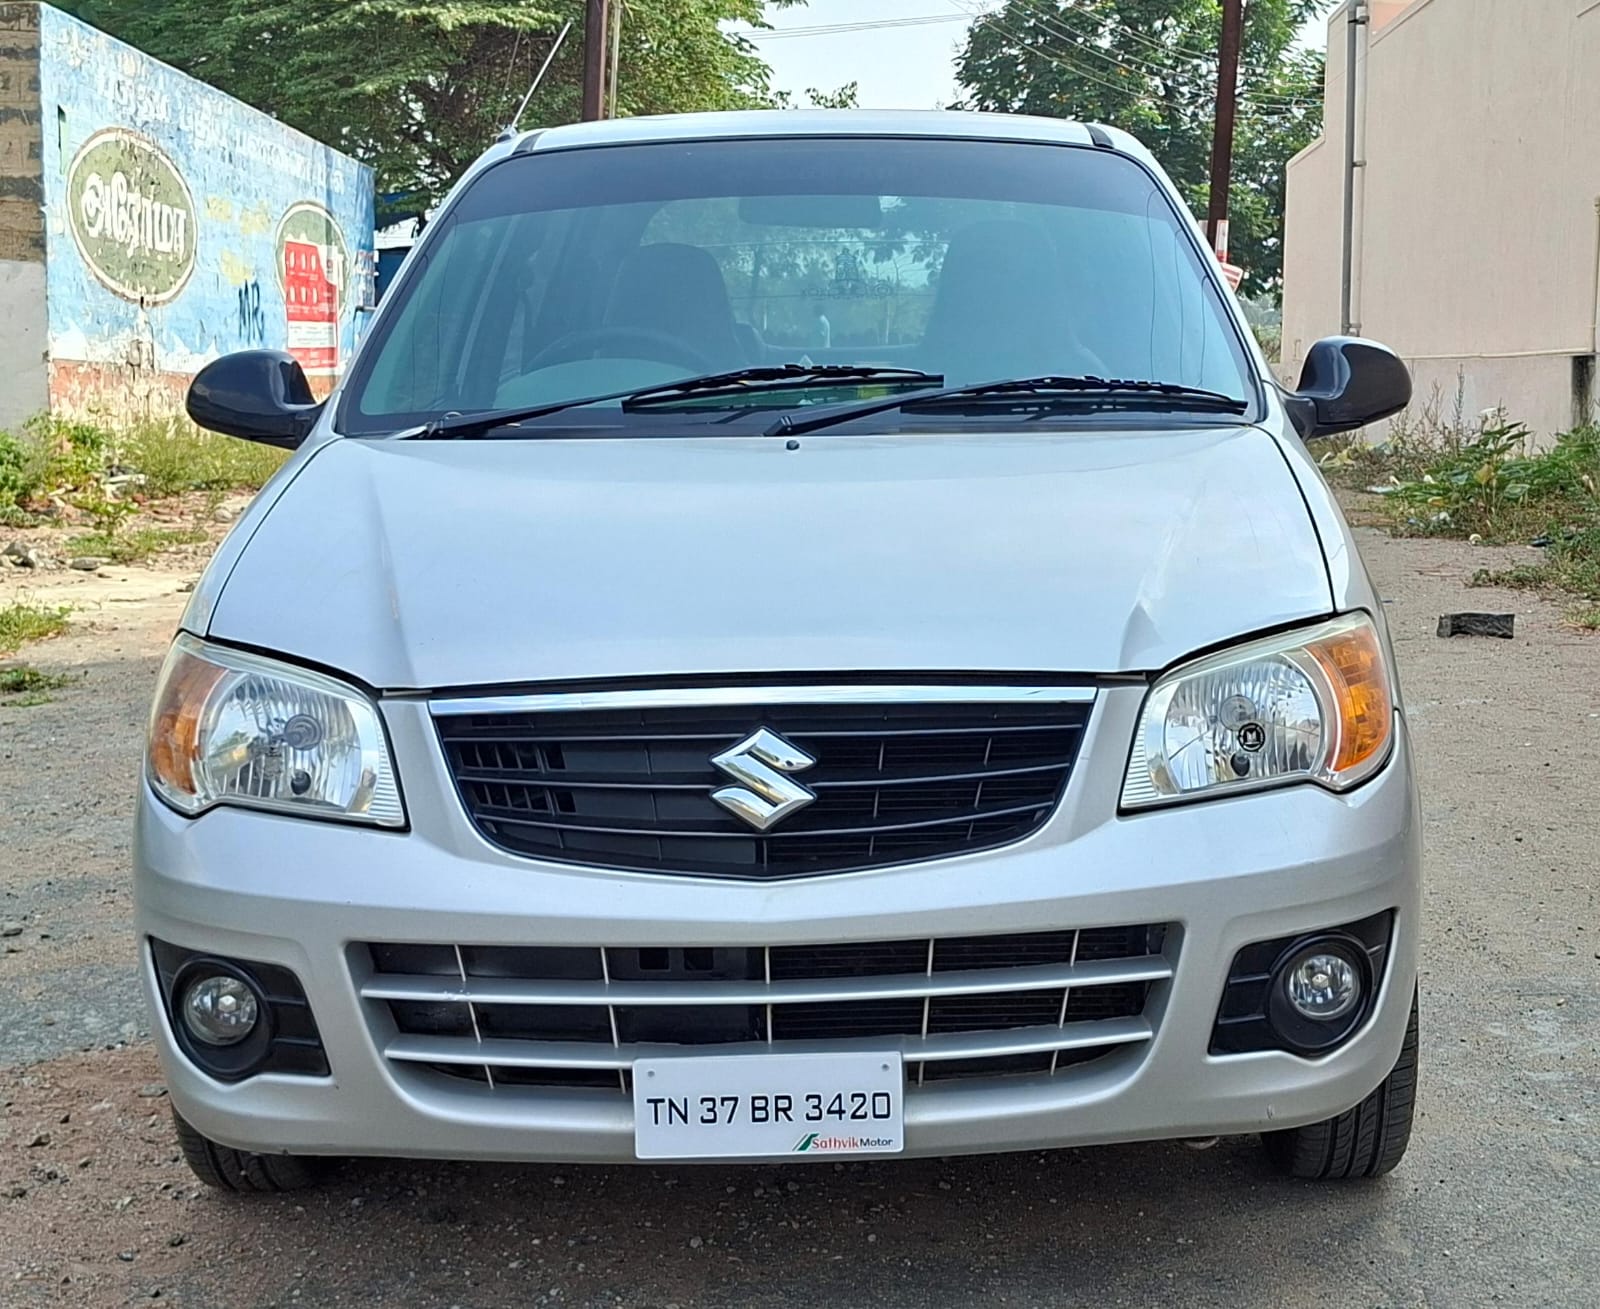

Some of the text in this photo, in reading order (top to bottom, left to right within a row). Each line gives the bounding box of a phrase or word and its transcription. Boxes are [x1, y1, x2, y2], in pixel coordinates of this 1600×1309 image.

[647, 1093, 890, 1124] TN 37 BR 3420
